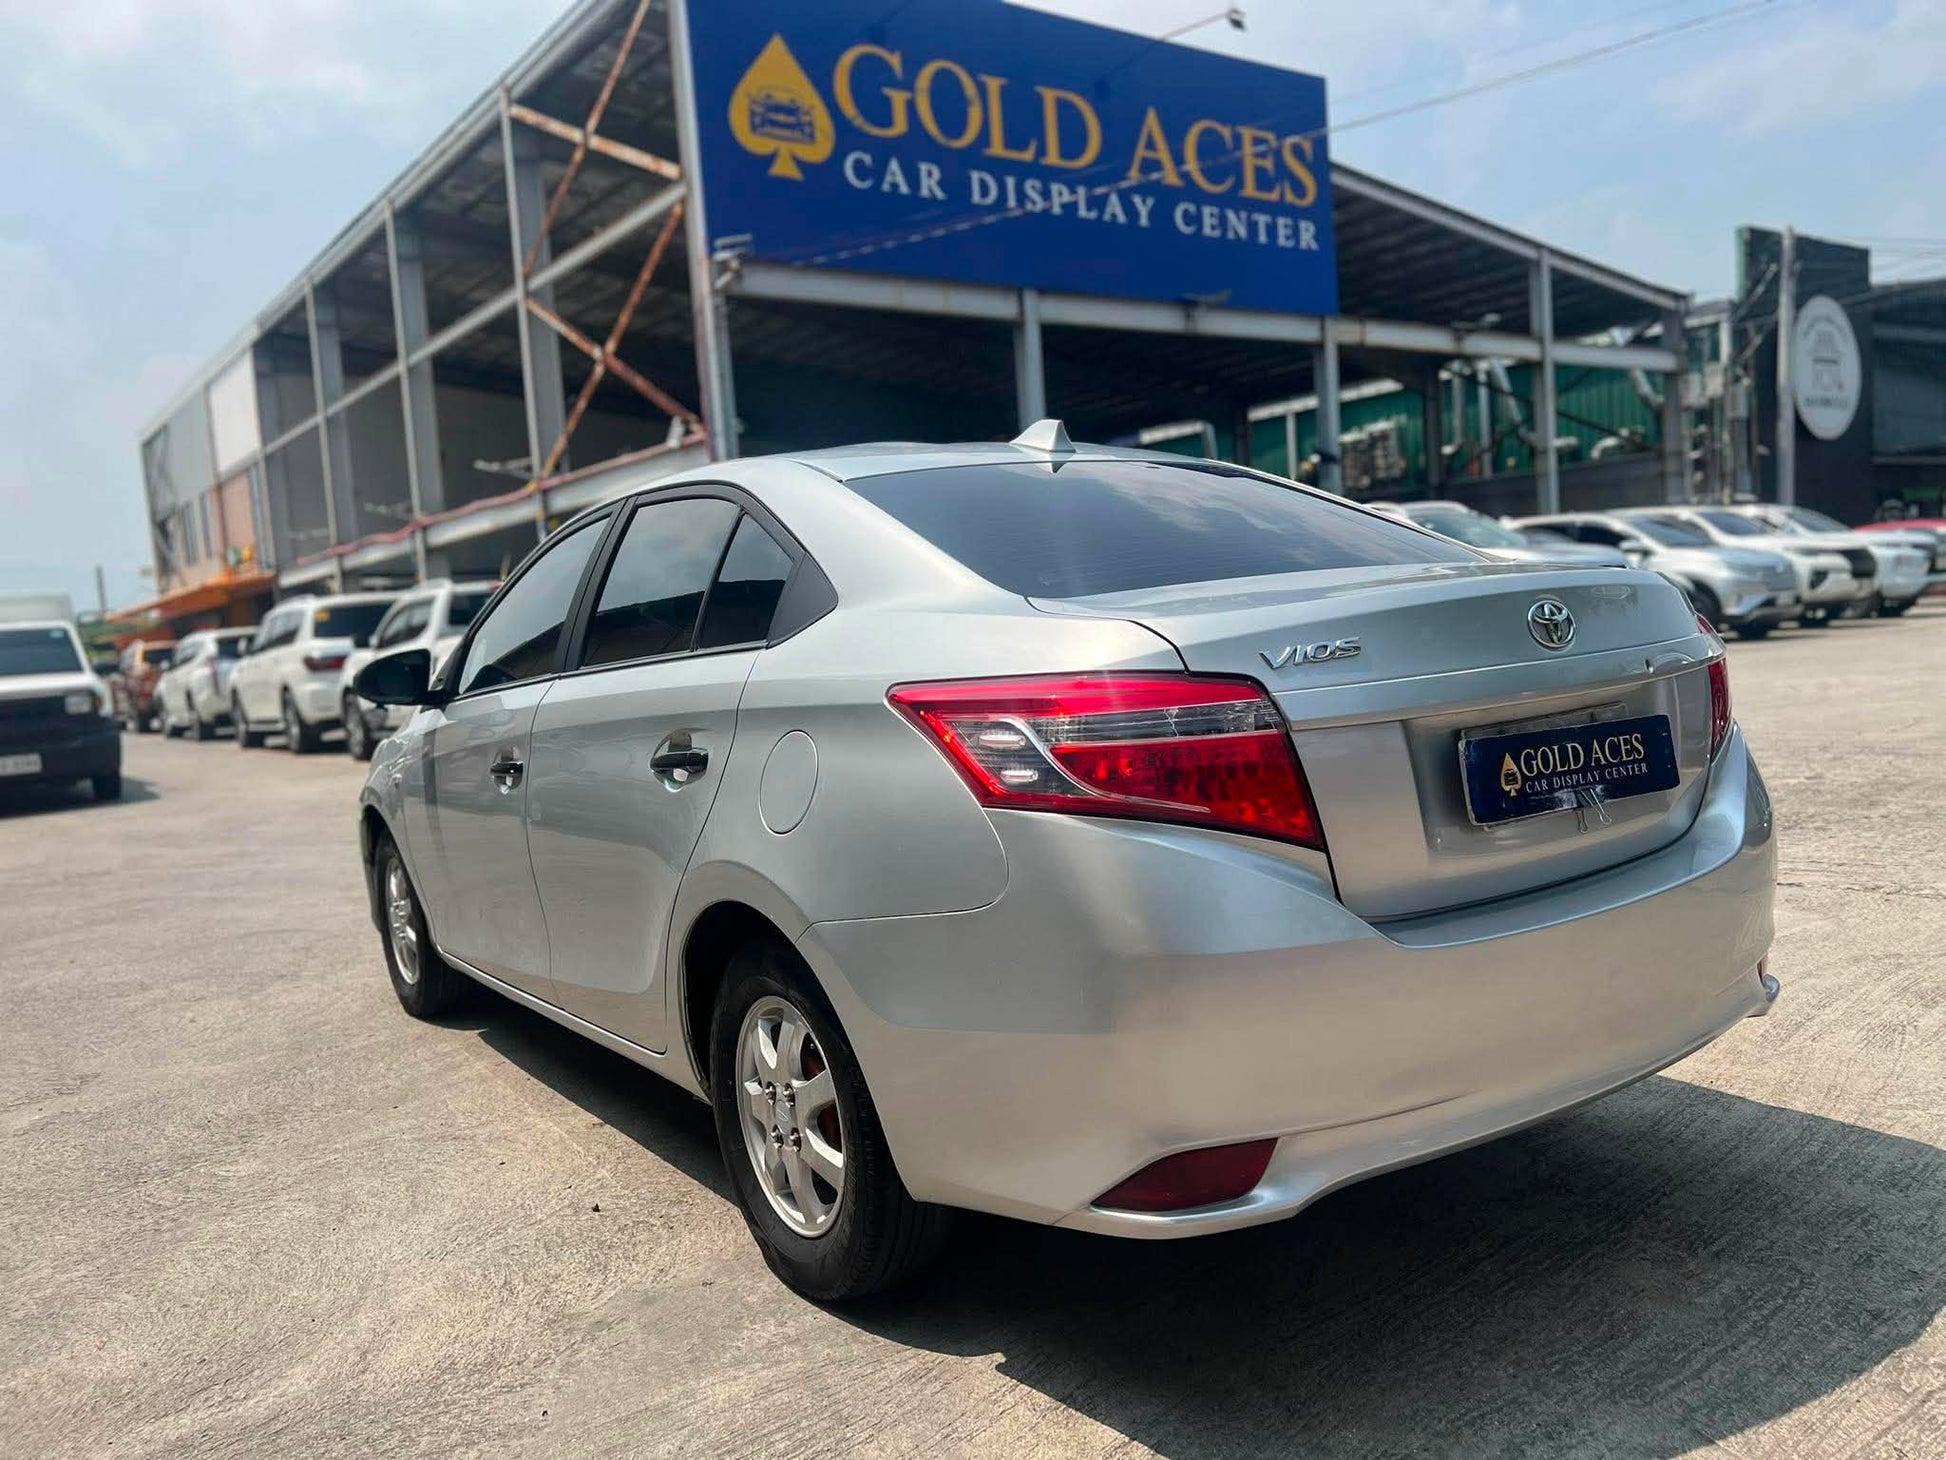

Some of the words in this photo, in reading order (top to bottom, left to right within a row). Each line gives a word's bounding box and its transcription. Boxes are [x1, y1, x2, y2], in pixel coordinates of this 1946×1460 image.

[834, 44, 1102, 169] GOLD
[1129, 107, 1318, 206] ACES
[843, 151, 947, 200] CAR
[970, 170, 1155, 227] DISPLAY
[1174, 201, 1320, 252] CENTER
[1259, 637, 1361, 669] VIOS
[1521, 743, 1584, 776] GOLD
[1592, 734, 1644, 765] ACES
[1526, 780, 1548, 793] CAR
[1553, 771, 1600, 788] DISPLAY
[1606, 763, 1648, 779] CENTER
